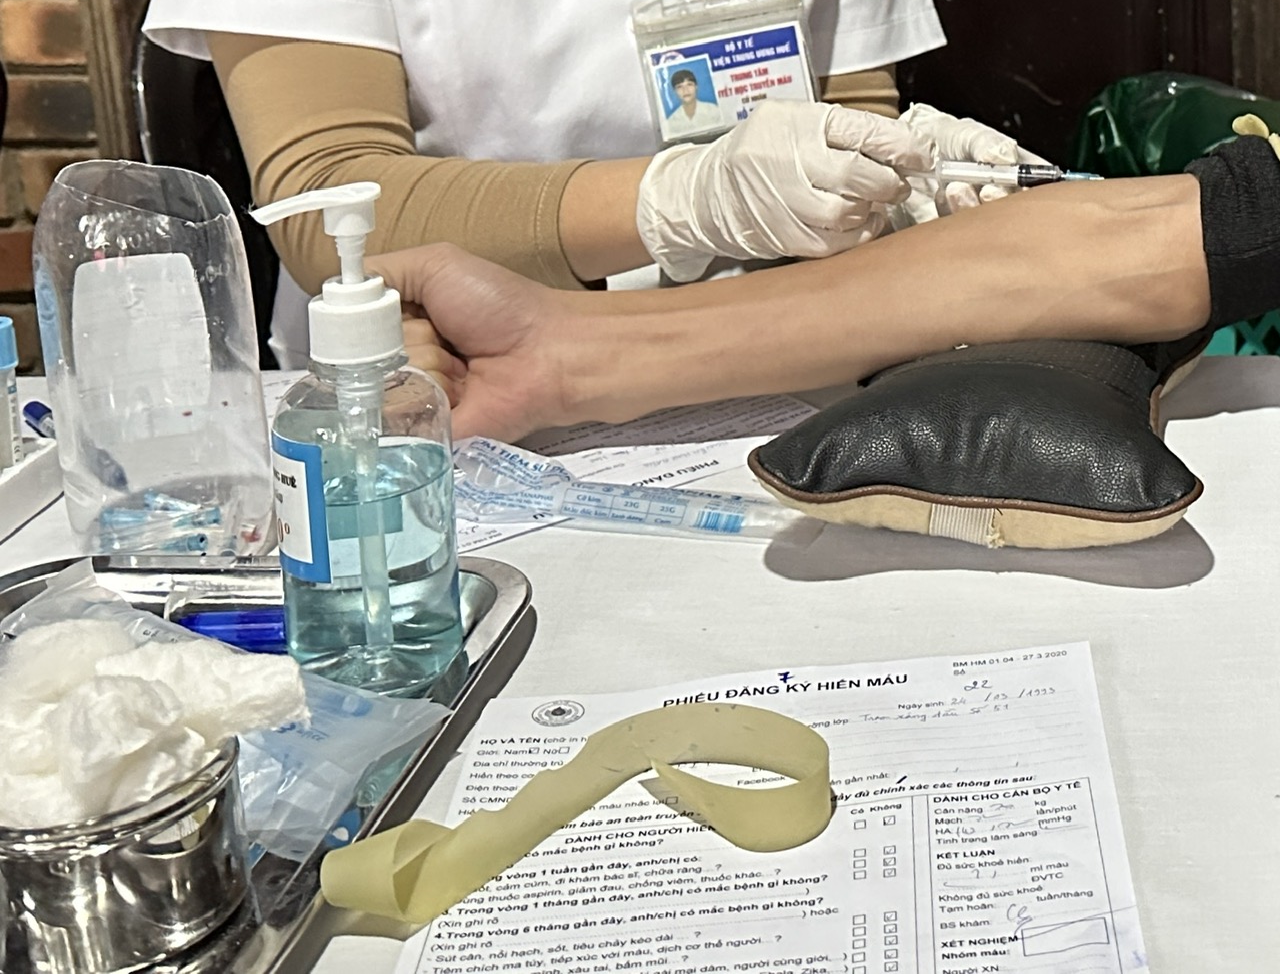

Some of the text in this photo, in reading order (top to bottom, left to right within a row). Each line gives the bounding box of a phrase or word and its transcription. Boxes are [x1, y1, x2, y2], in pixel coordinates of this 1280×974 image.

[737, 41, 742, 49] Y
[663, 674, 908, 708] PHIẾU ĐĂNG KÝ HIẾN MÁU
[737, 774, 786, 786] Facebook
[873, 785, 906, 797] chính
[909, 783, 930, 791] xác
[933, 781, 953, 790] các
[957, 780, 991, 789] thông
[994, 777, 1009, 785] tin
[870, 803, 902, 812] Không
[933, 795, 969, 804] DÀNH
[972, 792, 999, 801] CHO
[1002, 788, 1029, 798] CÁN
[1033, 786, 1051, 796] BỘ
[1054, 784, 1063, 792] Y
[1034, 799, 1047, 808] kg
[606, 815, 621, 825] an
[565, 826, 683, 844] DÀNH CHO NGƯỜI
[542, 839, 664, 856] mắc bệnh không?
[506, 871, 537, 880] vòng
[551, 865, 578, 875] tuần
[636, 856, 680, 867] anh/chị
[1046, 862, 1069, 871] máu
[569, 874, 600, 883] khám
[457, 874, 828, 916] Trong vòng tháng gần anh/chị có mắc bệnh không?
[939, 892, 973, 903] Không
[488, 897, 824, 937] vòng tháng gần anh/chị có mắc bệnh không?
[465, 919, 484, 929] ghi
[458, 942, 477, 952] ghi
[941, 935, 1018, 949] XÉT NGHIỆM
[942, 950, 978, 960] Nhóm
[466, 963, 499, 973] chích
